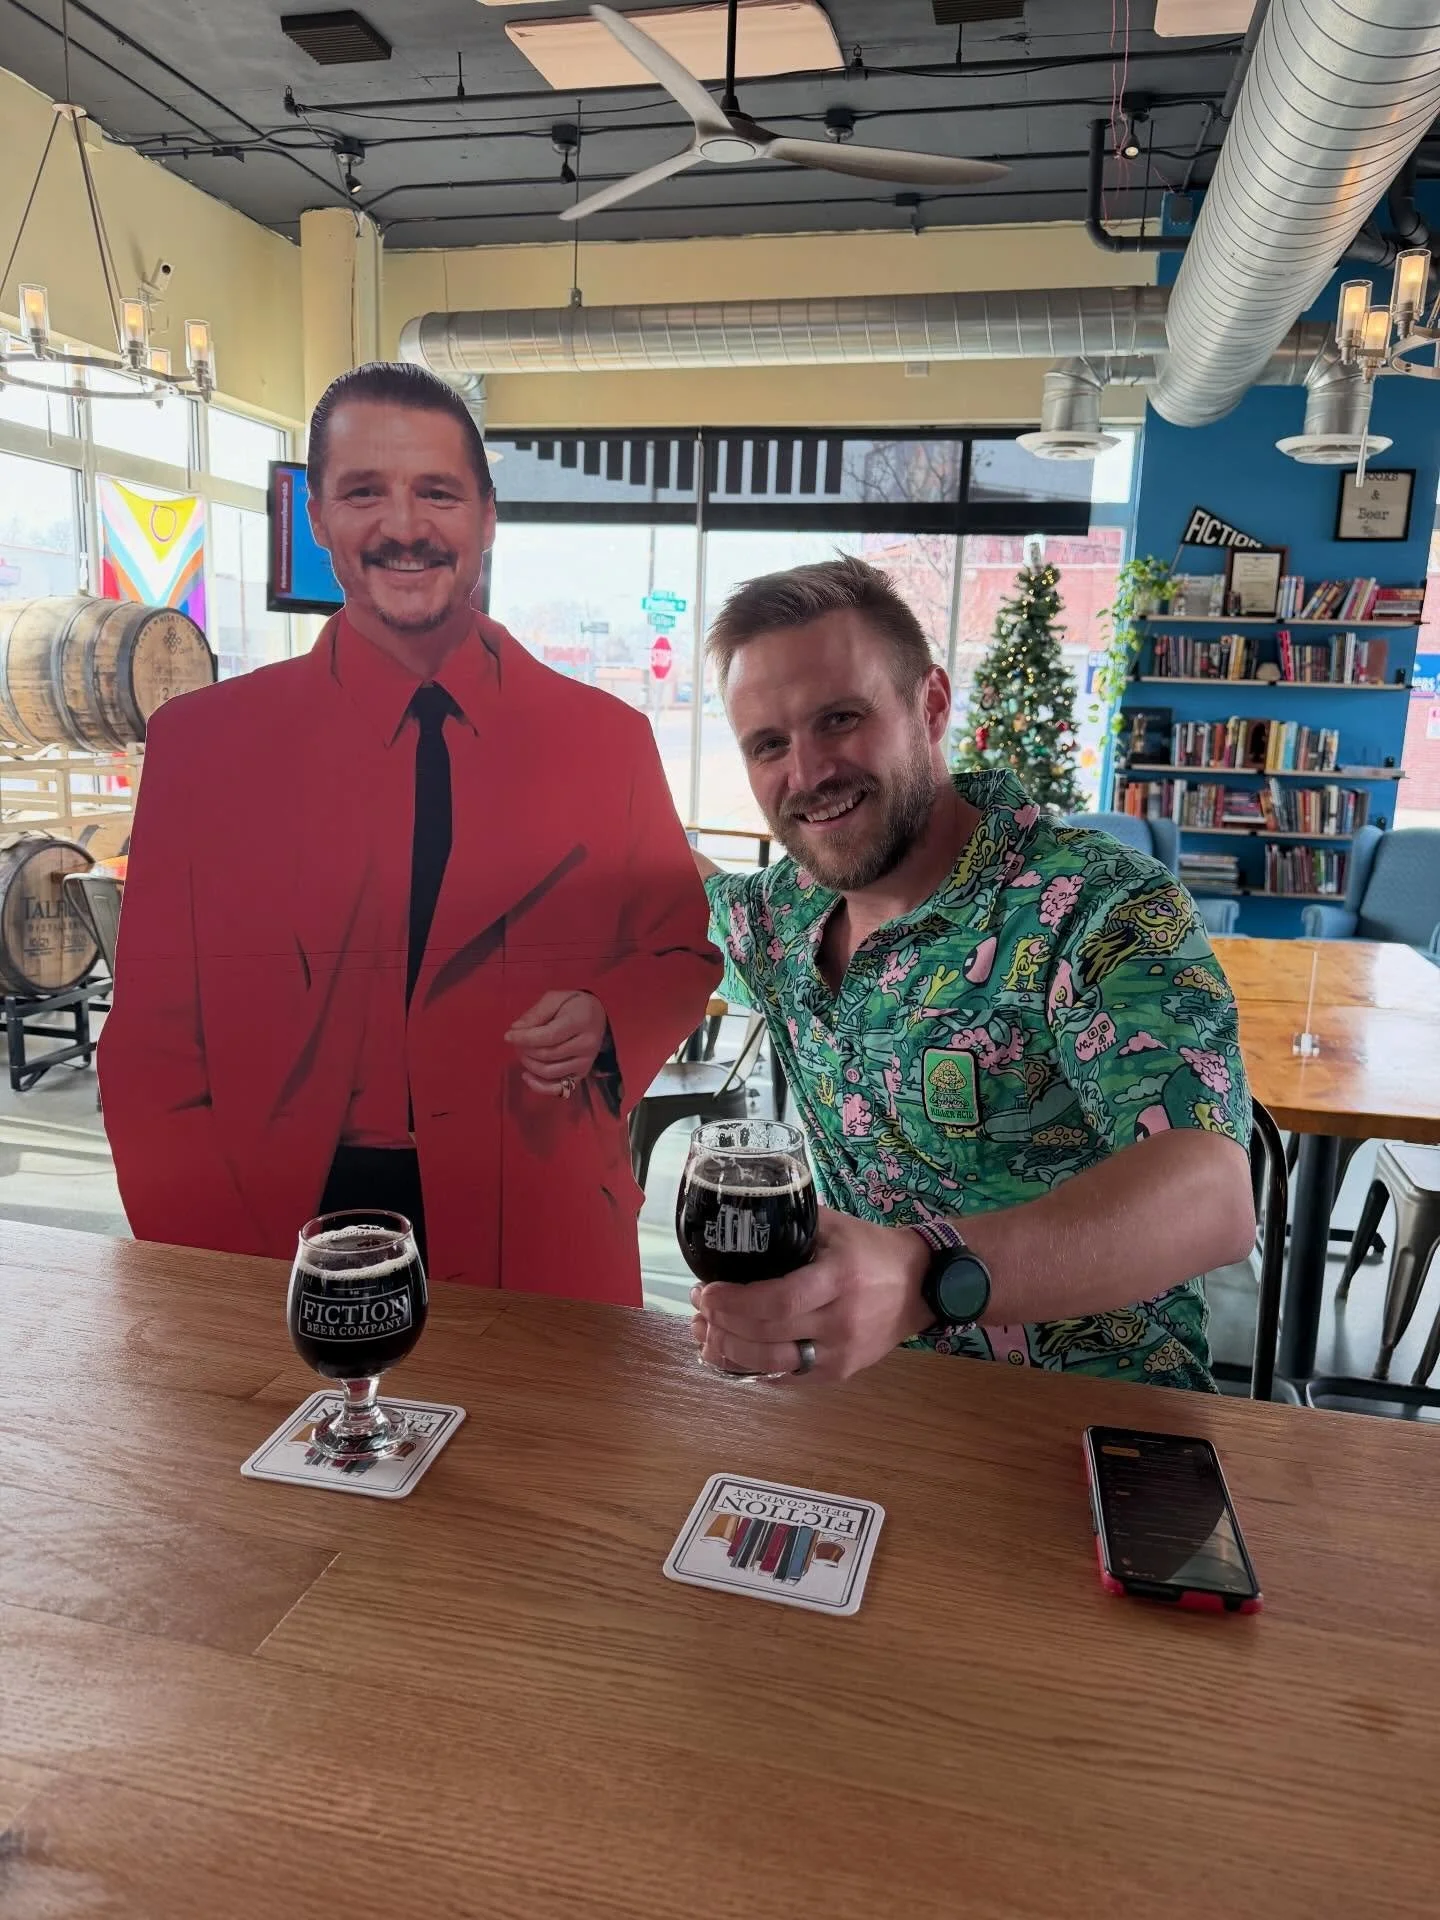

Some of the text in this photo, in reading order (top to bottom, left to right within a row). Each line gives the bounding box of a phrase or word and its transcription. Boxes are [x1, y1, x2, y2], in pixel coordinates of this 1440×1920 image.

[1184, 509, 1263, 549] FICTION
[931, 1107, 974, 1119] KILLER ACID
[302, 1294, 409, 1325] FICTION
[307, 1317, 402, 1336] BEER COMPANY
[719, 1495, 857, 1534] FICTION
[733, 1489, 850, 1518] BEER COMPANY
